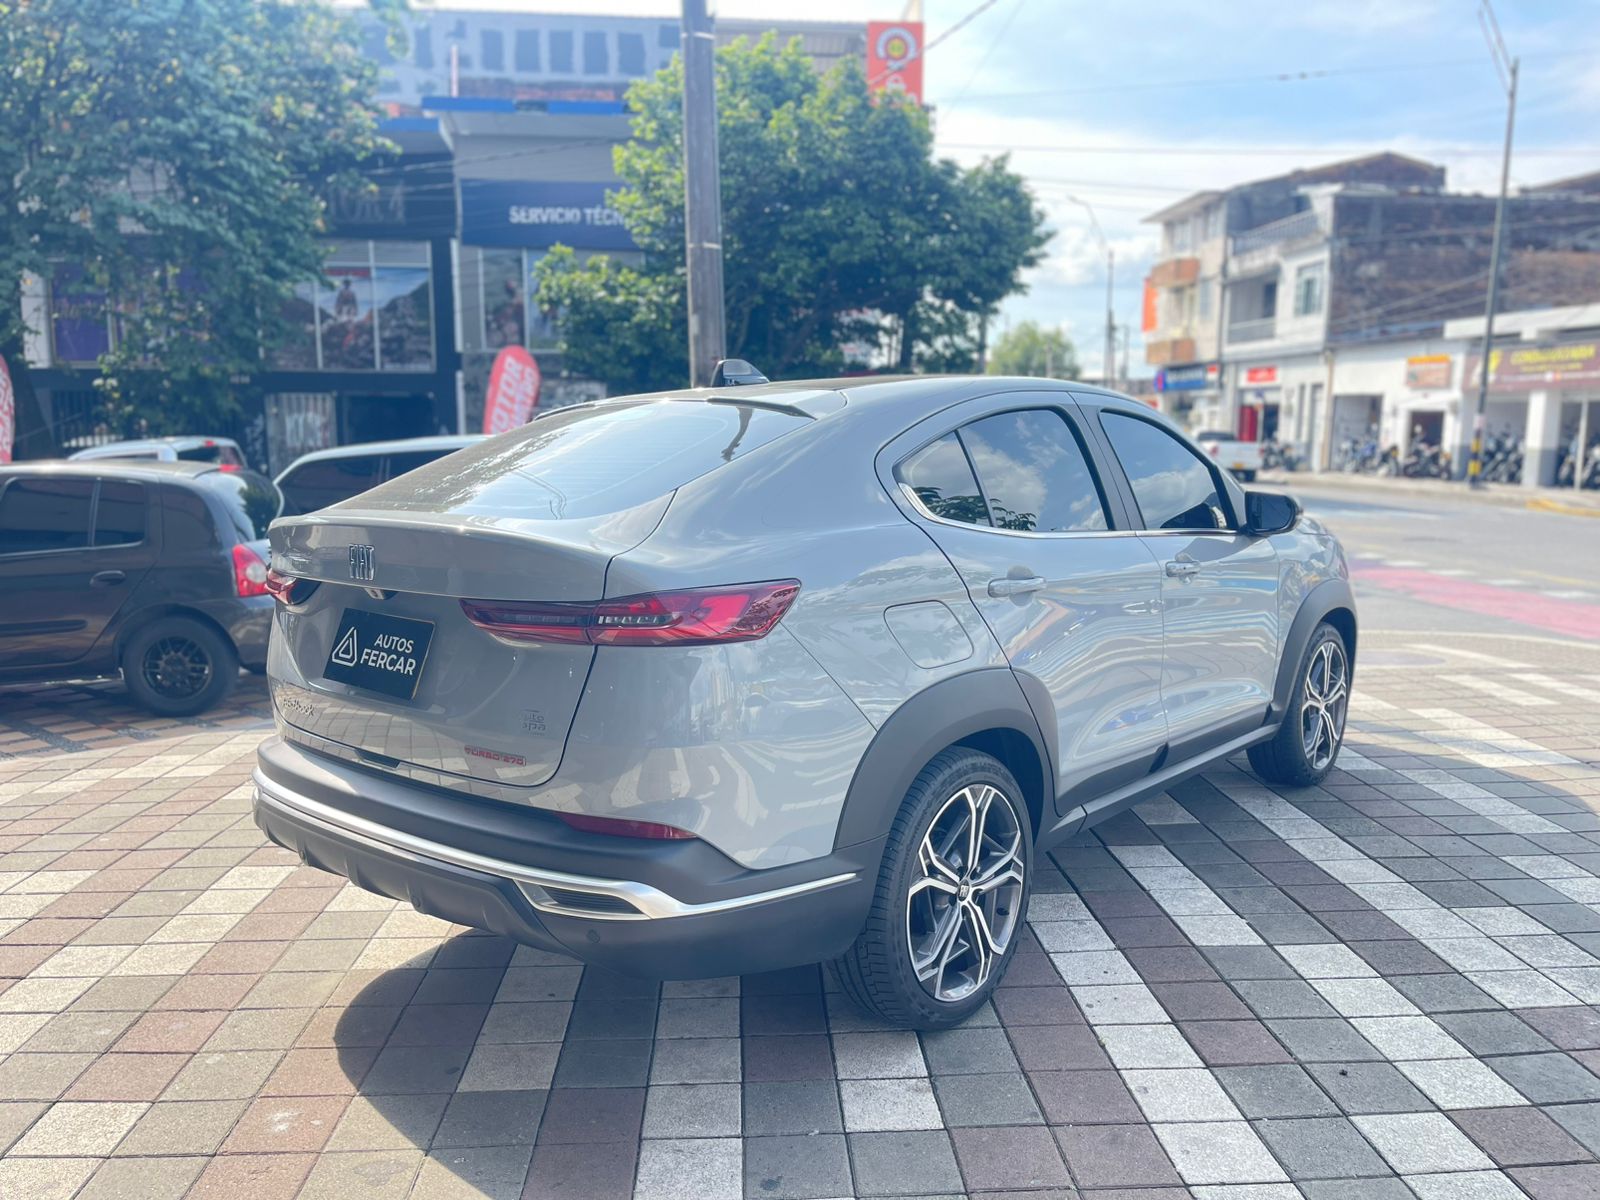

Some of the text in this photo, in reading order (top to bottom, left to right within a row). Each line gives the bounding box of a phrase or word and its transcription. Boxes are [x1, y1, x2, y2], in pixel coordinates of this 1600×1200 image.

[508, 205, 581, 224] SERVICIO
[349, 544, 375, 581] FIAT
[374, 633, 414, 654] AUTOS
[360, 648, 416, 676] FERCAR
[464, 745, 500, 761] TURBO
